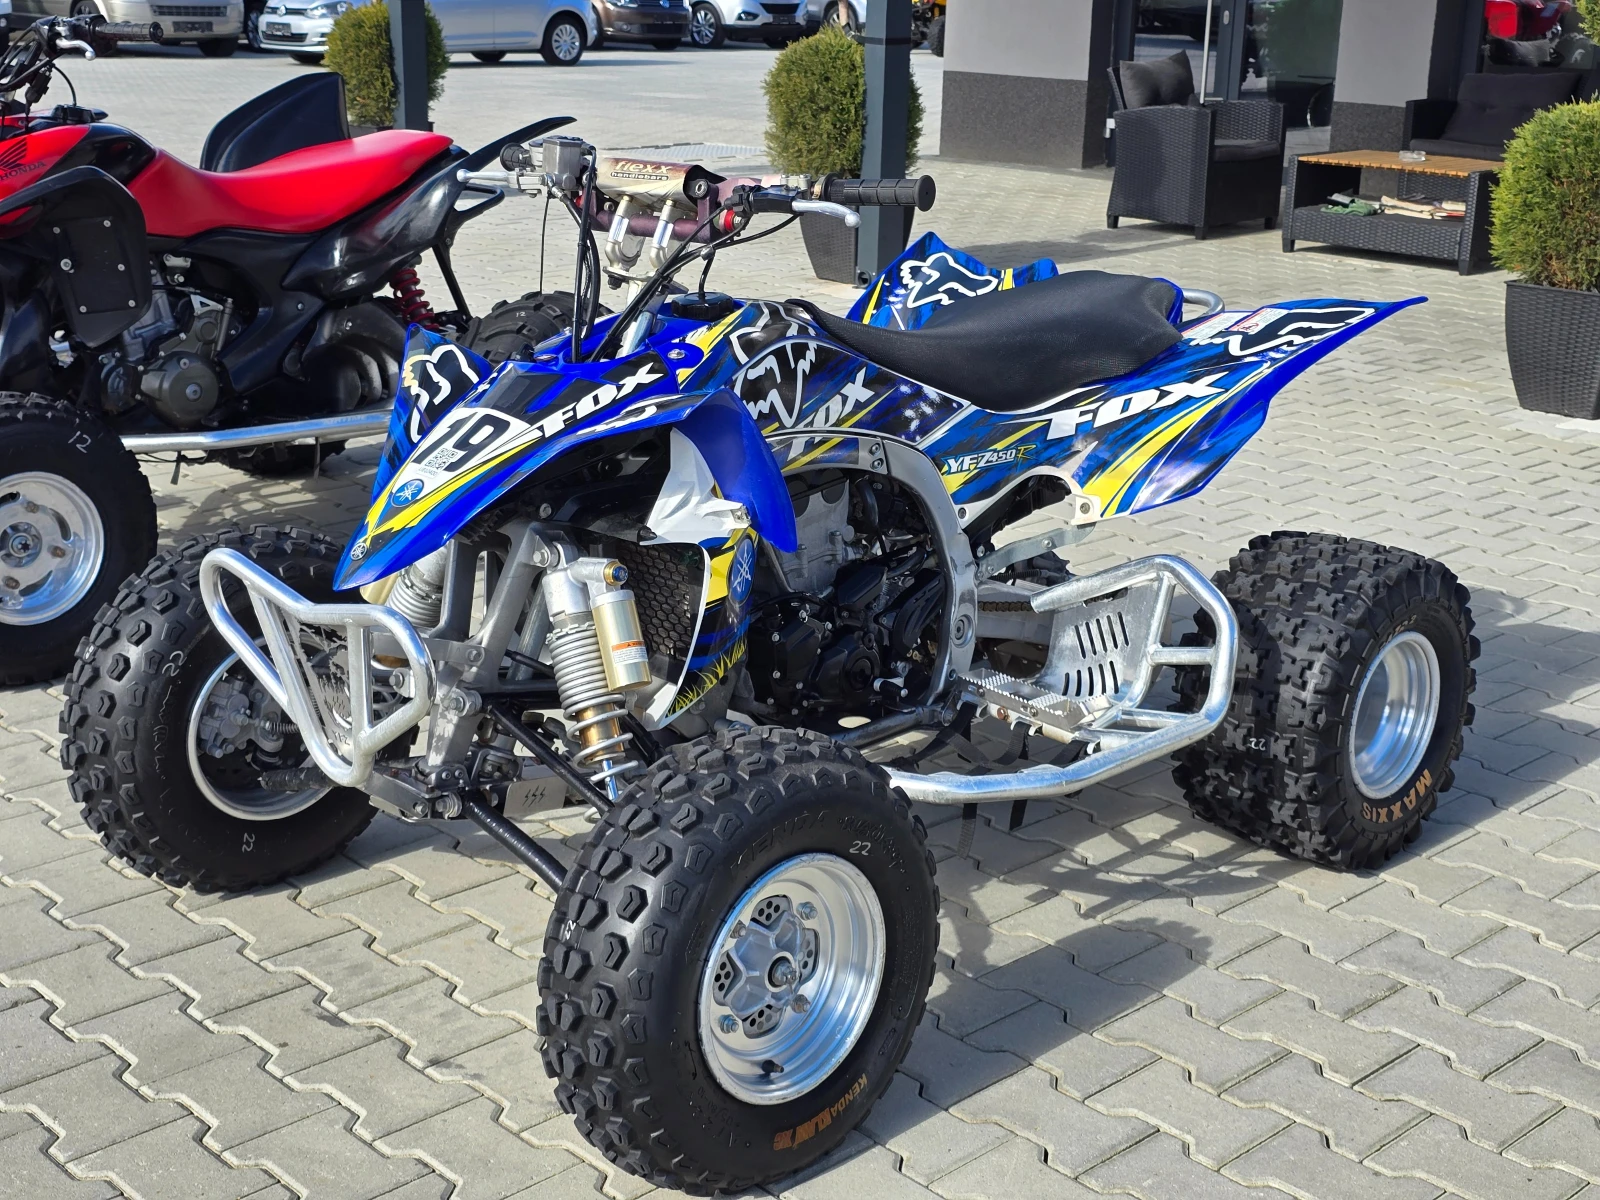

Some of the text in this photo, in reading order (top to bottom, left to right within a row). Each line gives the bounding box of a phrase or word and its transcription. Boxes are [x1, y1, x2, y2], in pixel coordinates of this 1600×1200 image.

[0, 161, 47, 180] HONDA
[614, 160, 673, 174] flexx
[538, 362, 665, 438] FOX
[786, 366, 875, 461] FOX
[1026, 371, 1226, 440] FOX
[67, 430, 92, 454] 12
[410, 411, 512, 473] 19
[1362, 768, 1433, 824] MAXXIS
[242, 832, 256, 854] 22
[849, 840, 872, 856] 22
[829, 1072, 868, 1118] KENDA
